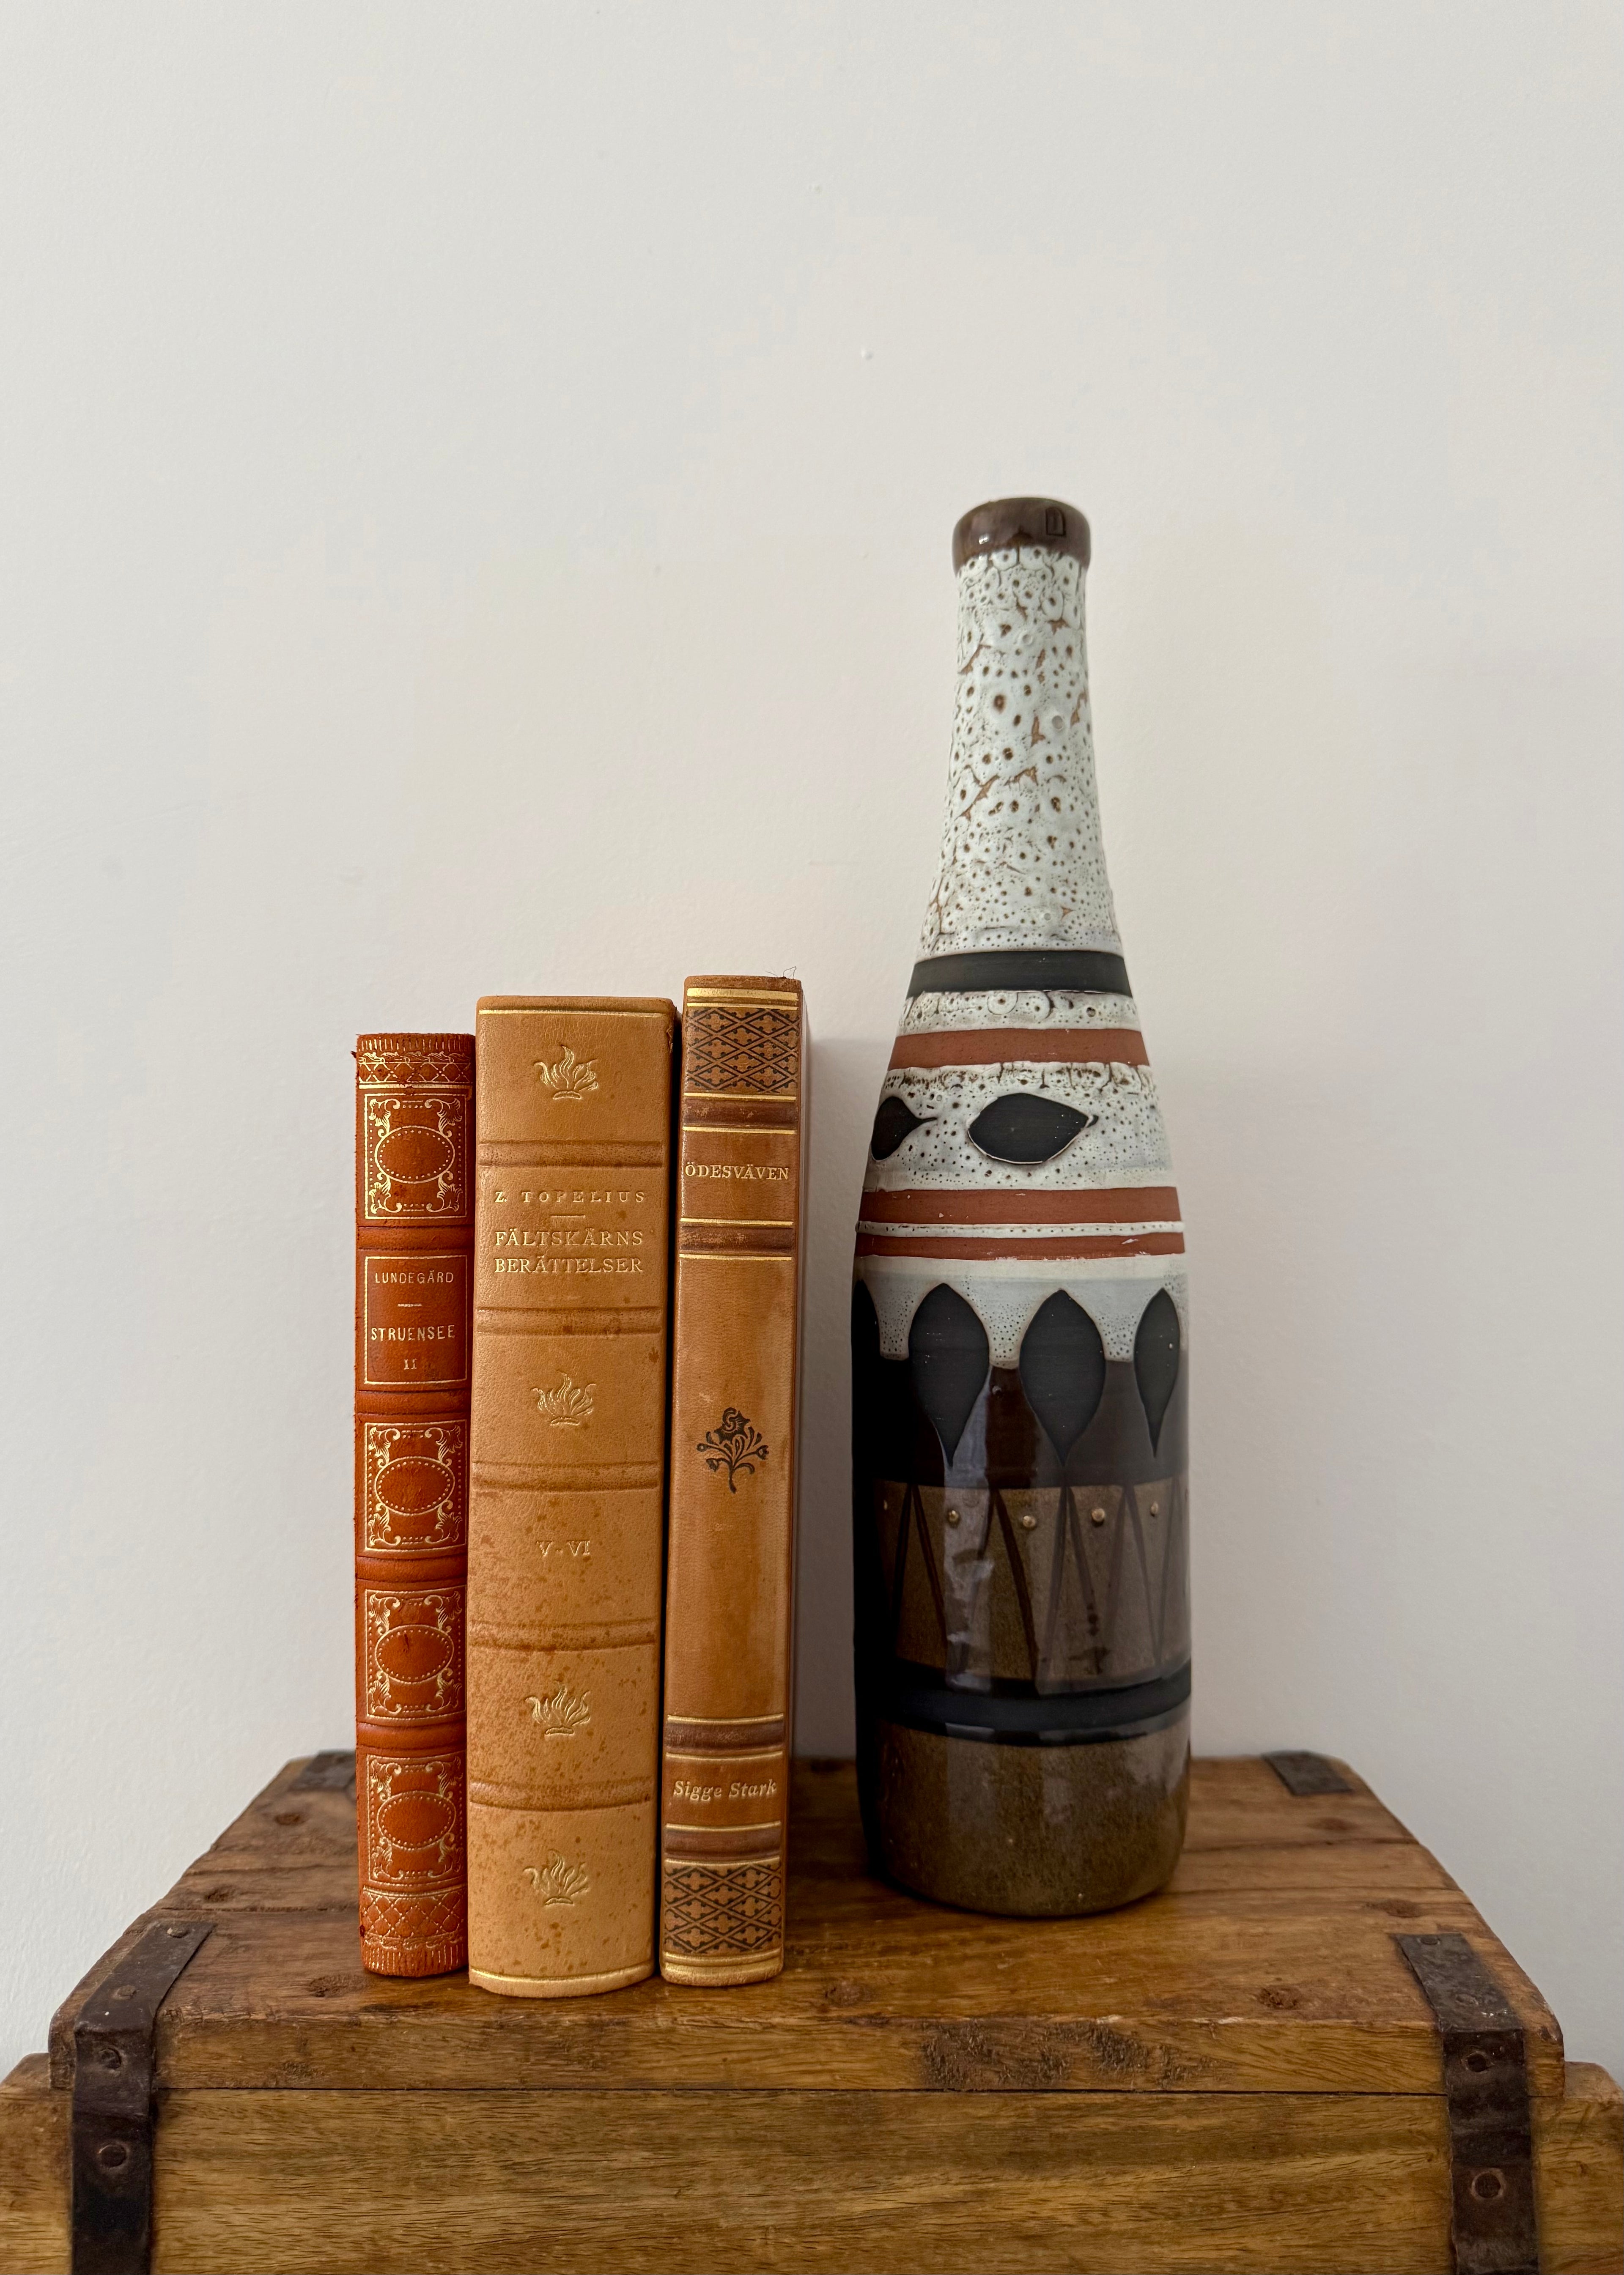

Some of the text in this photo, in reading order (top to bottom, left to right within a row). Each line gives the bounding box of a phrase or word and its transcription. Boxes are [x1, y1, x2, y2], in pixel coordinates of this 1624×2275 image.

[685, 1162, 789, 1180] ÖDESVÄVEN
[494, 1191, 645, 1203] Z. TOPELIUS
[494, 1228, 643, 1246] FÄLTSKÄRNS
[494, 1255, 643, 1273] BERÄTTELSER
[371, 1325, 455, 1341] STRUENSEE
[673, 1779, 776, 1801] Sigge Stark
